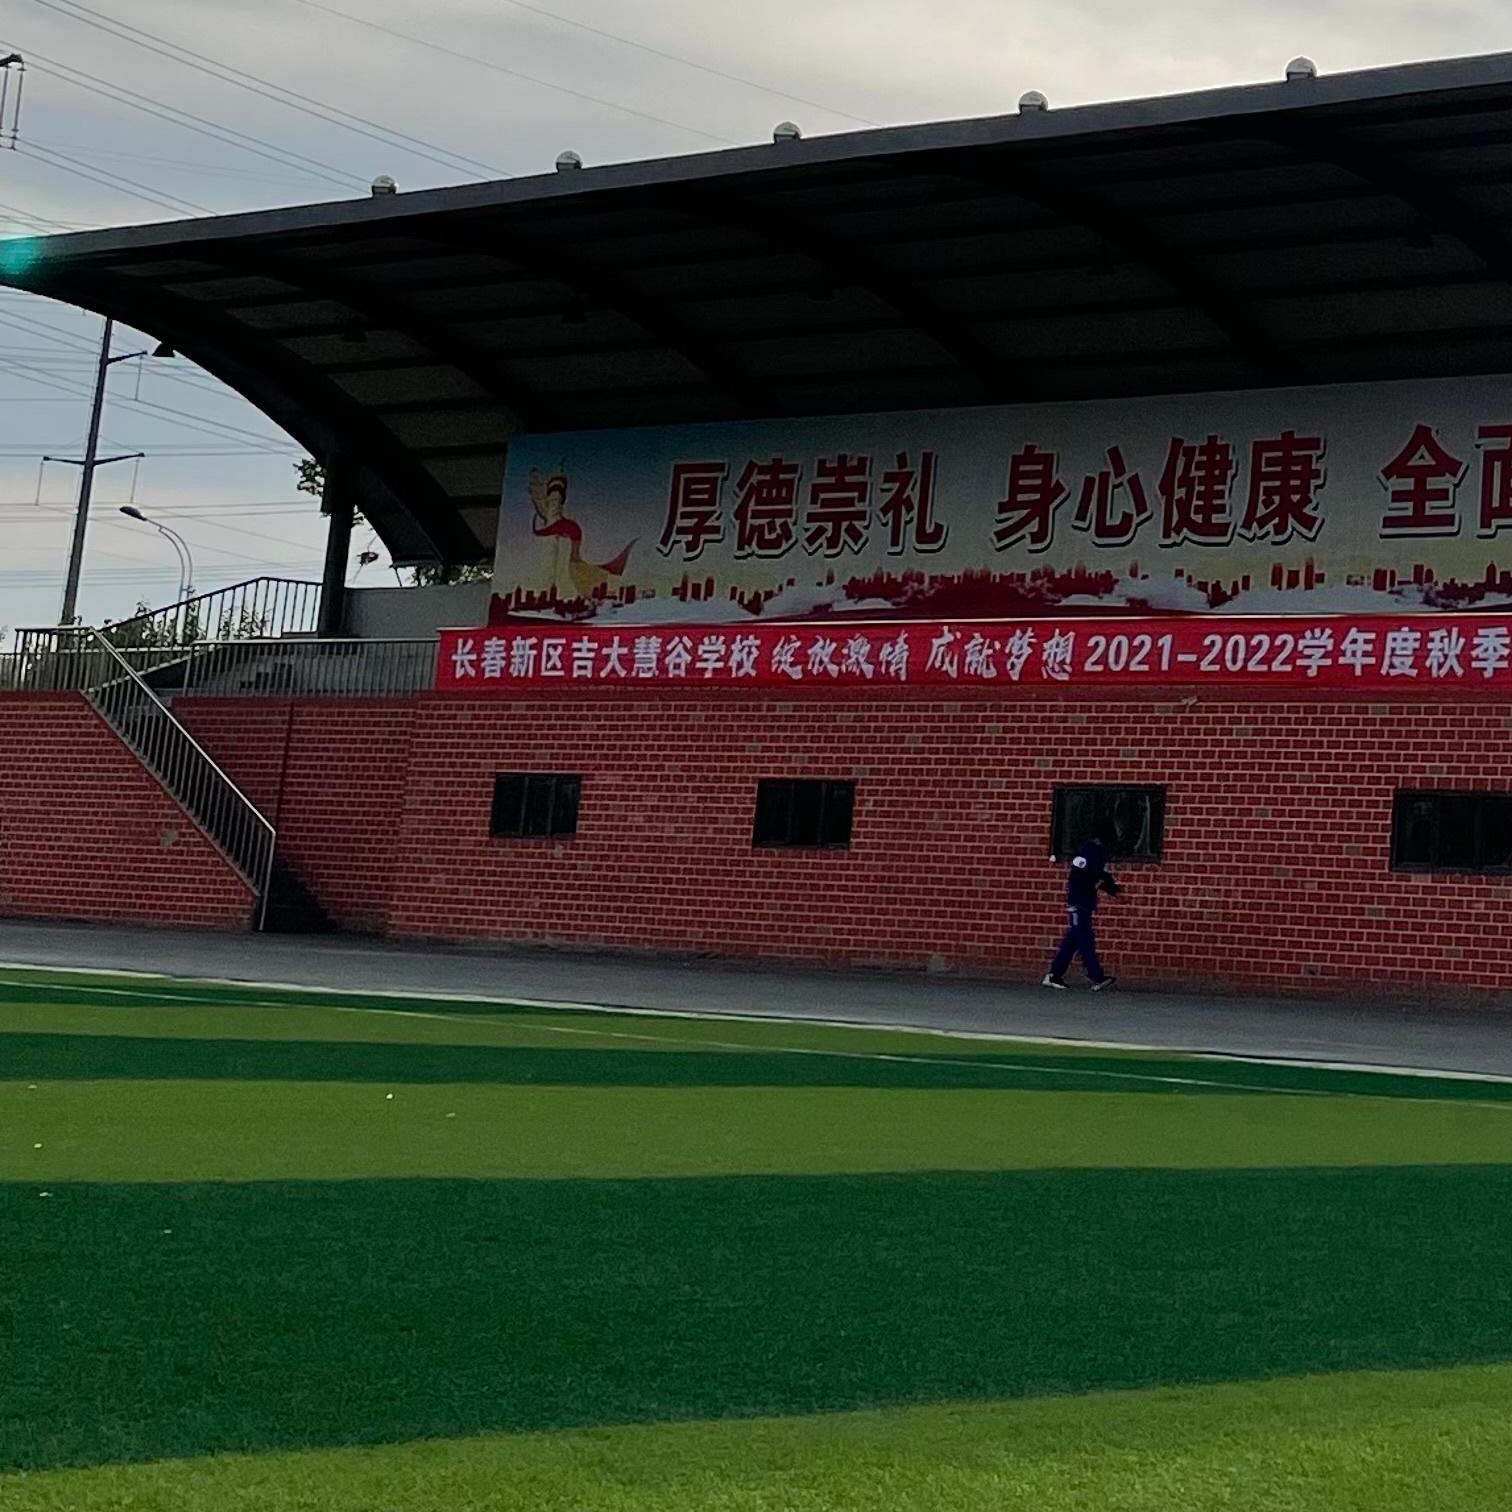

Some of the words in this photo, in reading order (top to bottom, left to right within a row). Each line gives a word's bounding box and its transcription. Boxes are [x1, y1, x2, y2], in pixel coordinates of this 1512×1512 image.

[657, 451, 947, 560] 厚德崇礼
[994, 431, 1325, 549] 身心健康
[452, 634, 758, 681] 长春新区吉大慧谷学校
[770, 632, 910, 682] 绽放激情
[924, 625, 1074, 682] 成就梦想
